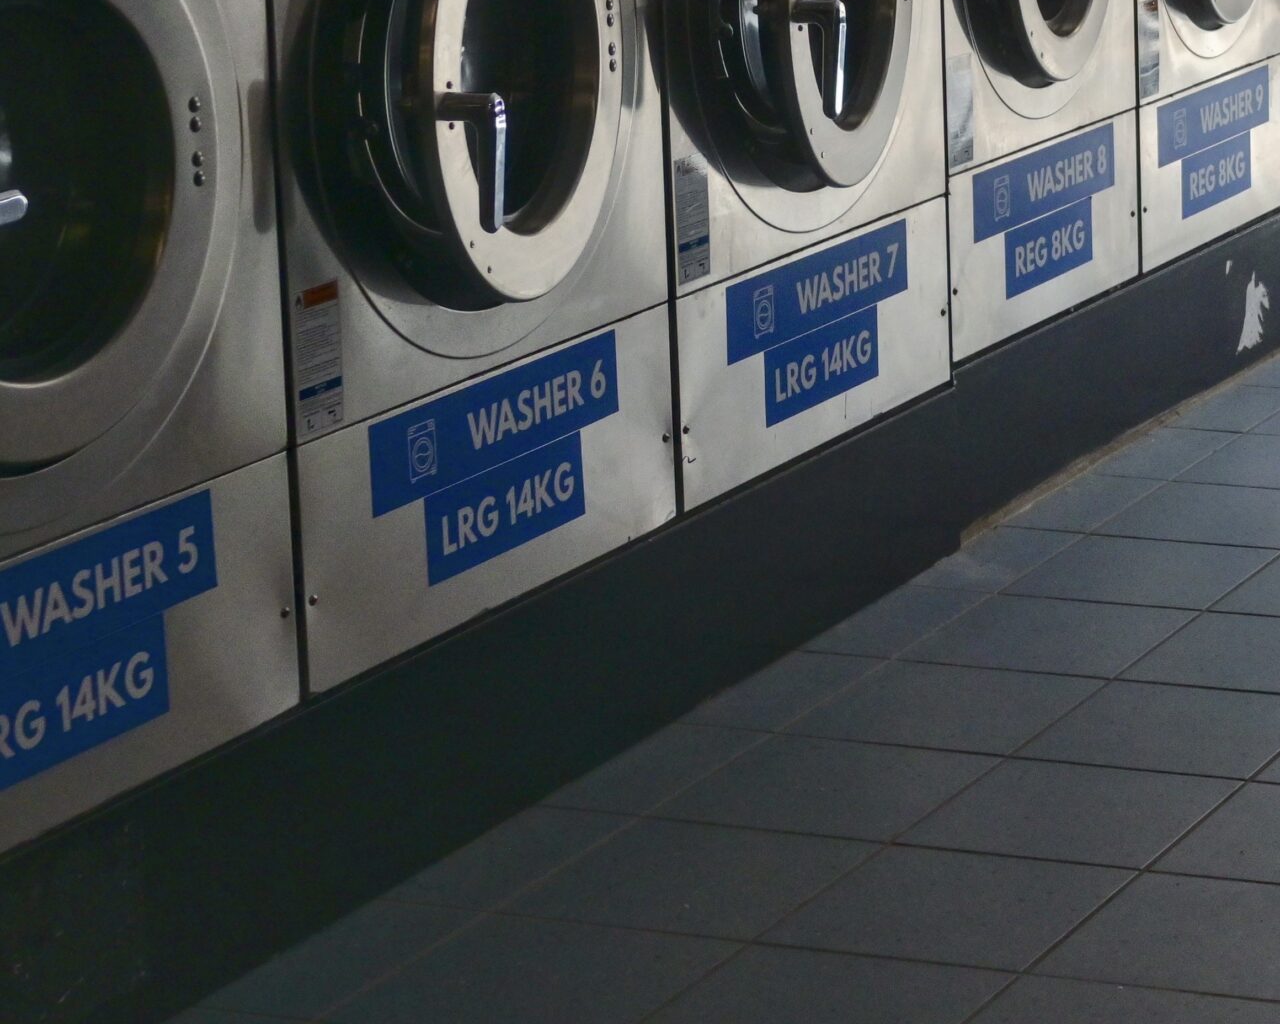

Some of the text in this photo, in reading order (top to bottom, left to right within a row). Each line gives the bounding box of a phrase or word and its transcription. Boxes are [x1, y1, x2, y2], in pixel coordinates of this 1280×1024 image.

[1200, 83, 1264, 134] WASHER 9
[1027, 144, 1107, 202] WASHER 8
[1189, 151, 1246, 201] REG 8KG
[796, 242, 899, 315] WASHER 7
[1015, 219, 1086, 278] REG 8KG
[774, 329, 872, 404] LRG 14KG
[466, 358, 607, 450] WASHER 6
[441, 461, 575, 557] LRG 14KG
[0, 525, 199, 649] WASHER 5
[55, 651, 155, 733] 14KG
